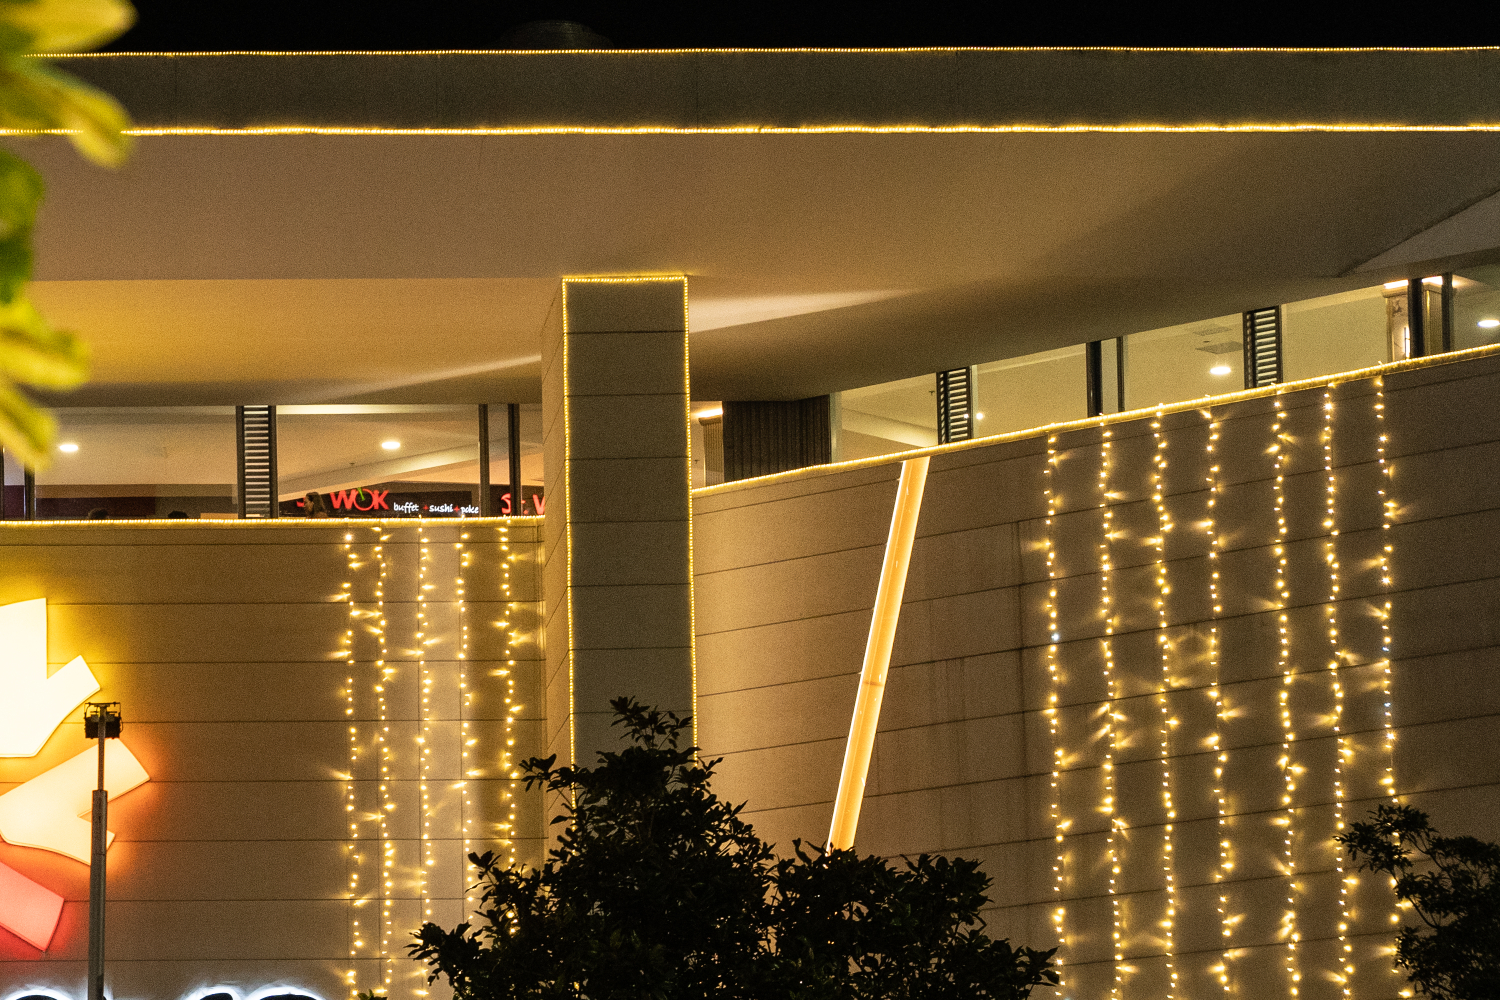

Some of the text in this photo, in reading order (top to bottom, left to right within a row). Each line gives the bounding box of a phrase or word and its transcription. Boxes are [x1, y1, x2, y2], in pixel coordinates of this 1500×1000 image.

[329, 488, 390, 511] WOK
[393, 502, 480, 514] buffet sushi poke
